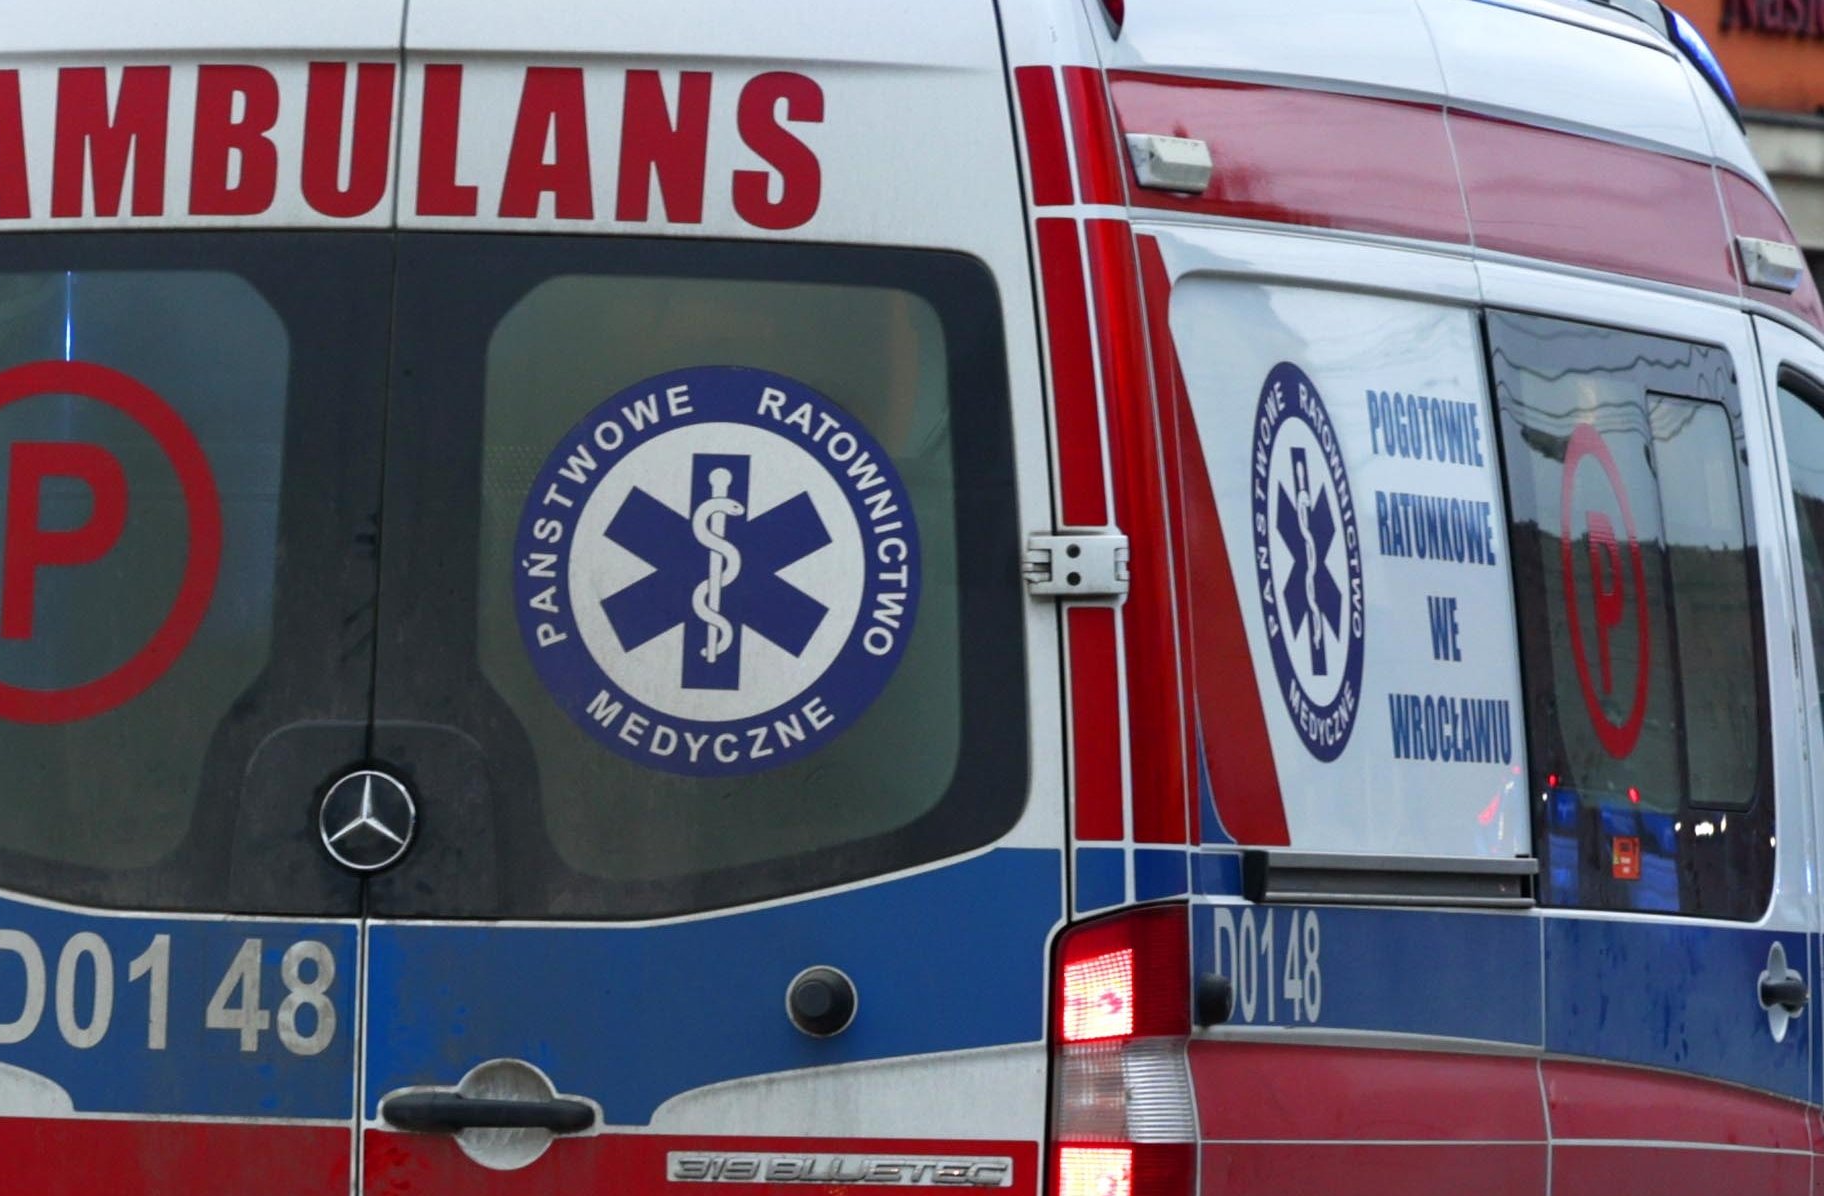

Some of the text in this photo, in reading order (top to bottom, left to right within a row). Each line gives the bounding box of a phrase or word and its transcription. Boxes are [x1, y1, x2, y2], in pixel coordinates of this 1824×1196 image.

[1366, 389, 1484, 467] POGOTOWIE
[523, 384, 908, 656] PAŃSTWOWE RATOWNICTWO
[1256, 381, 1363, 639] PAŃSTWOWE RATOWNICTWO
[1375, 490, 1496, 566] RATUNKOWE
[1427, 595, 1461, 662] WE
[1587, 513, 1623, 694] P
[586, 689, 836, 764] MEDYCZNE
[1289, 678, 1355, 747] MEDYCZNE
[1388, 693, 1512, 765] WROCŁAWIU
[675, 1155, 1011, 1187] 319 BLUETEC
